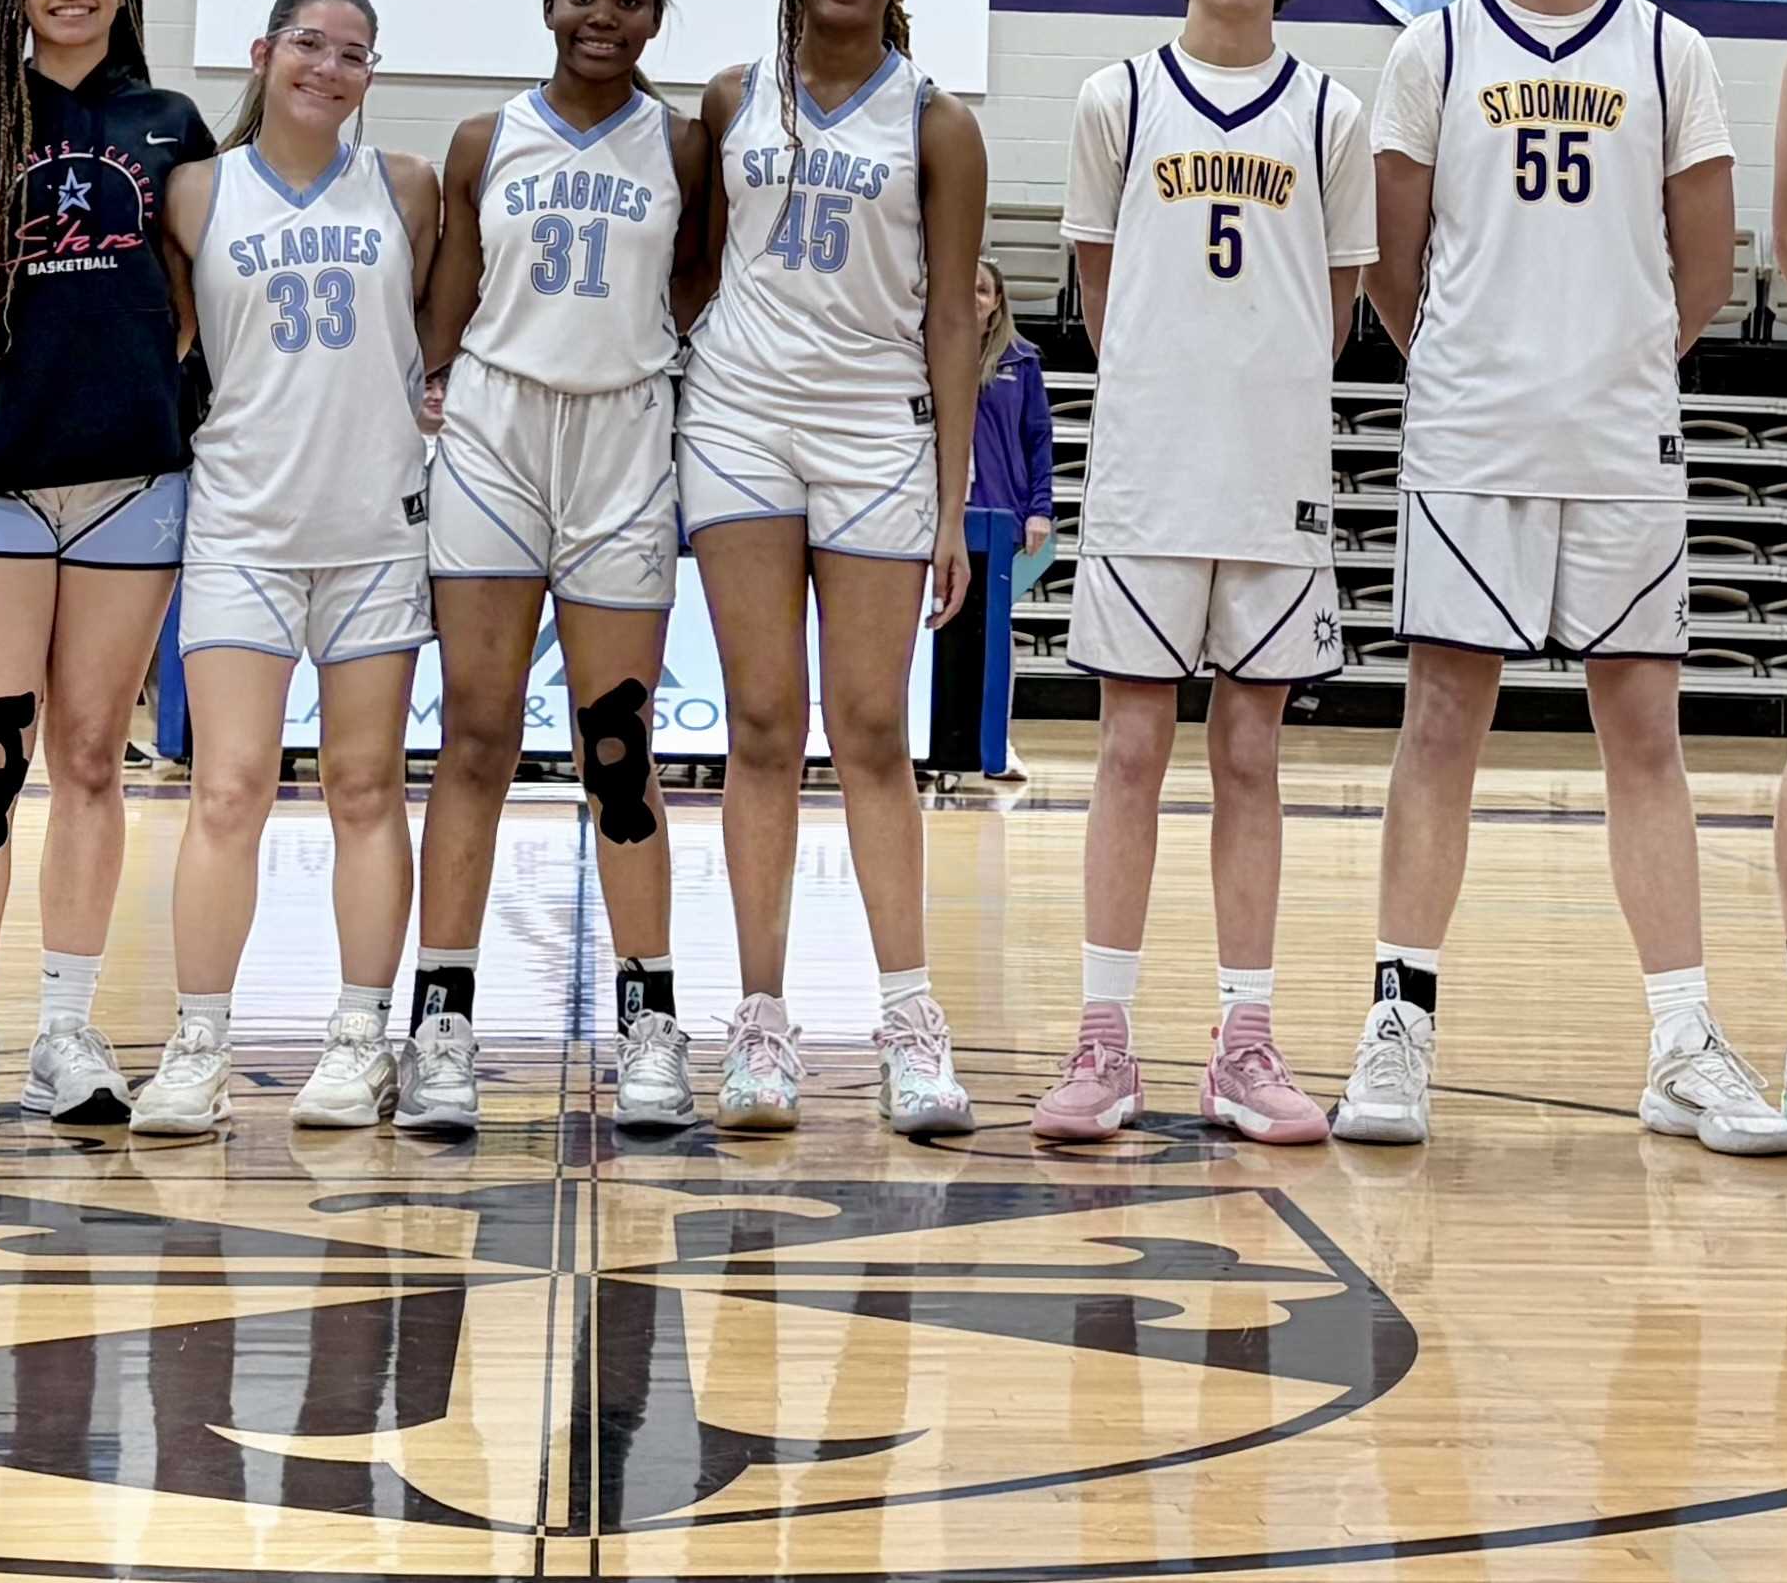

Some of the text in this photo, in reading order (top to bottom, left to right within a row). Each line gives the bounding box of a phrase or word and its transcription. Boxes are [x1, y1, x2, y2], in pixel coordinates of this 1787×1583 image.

[1514, 127, 1592, 205] 55
[27, 255, 118, 276] BASKETBALL
[530, 215, 610, 298] 31
[767, 194, 853, 274] 45
[1208, 203, 1244, 280] 5
[266, 268, 357, 354] 33
